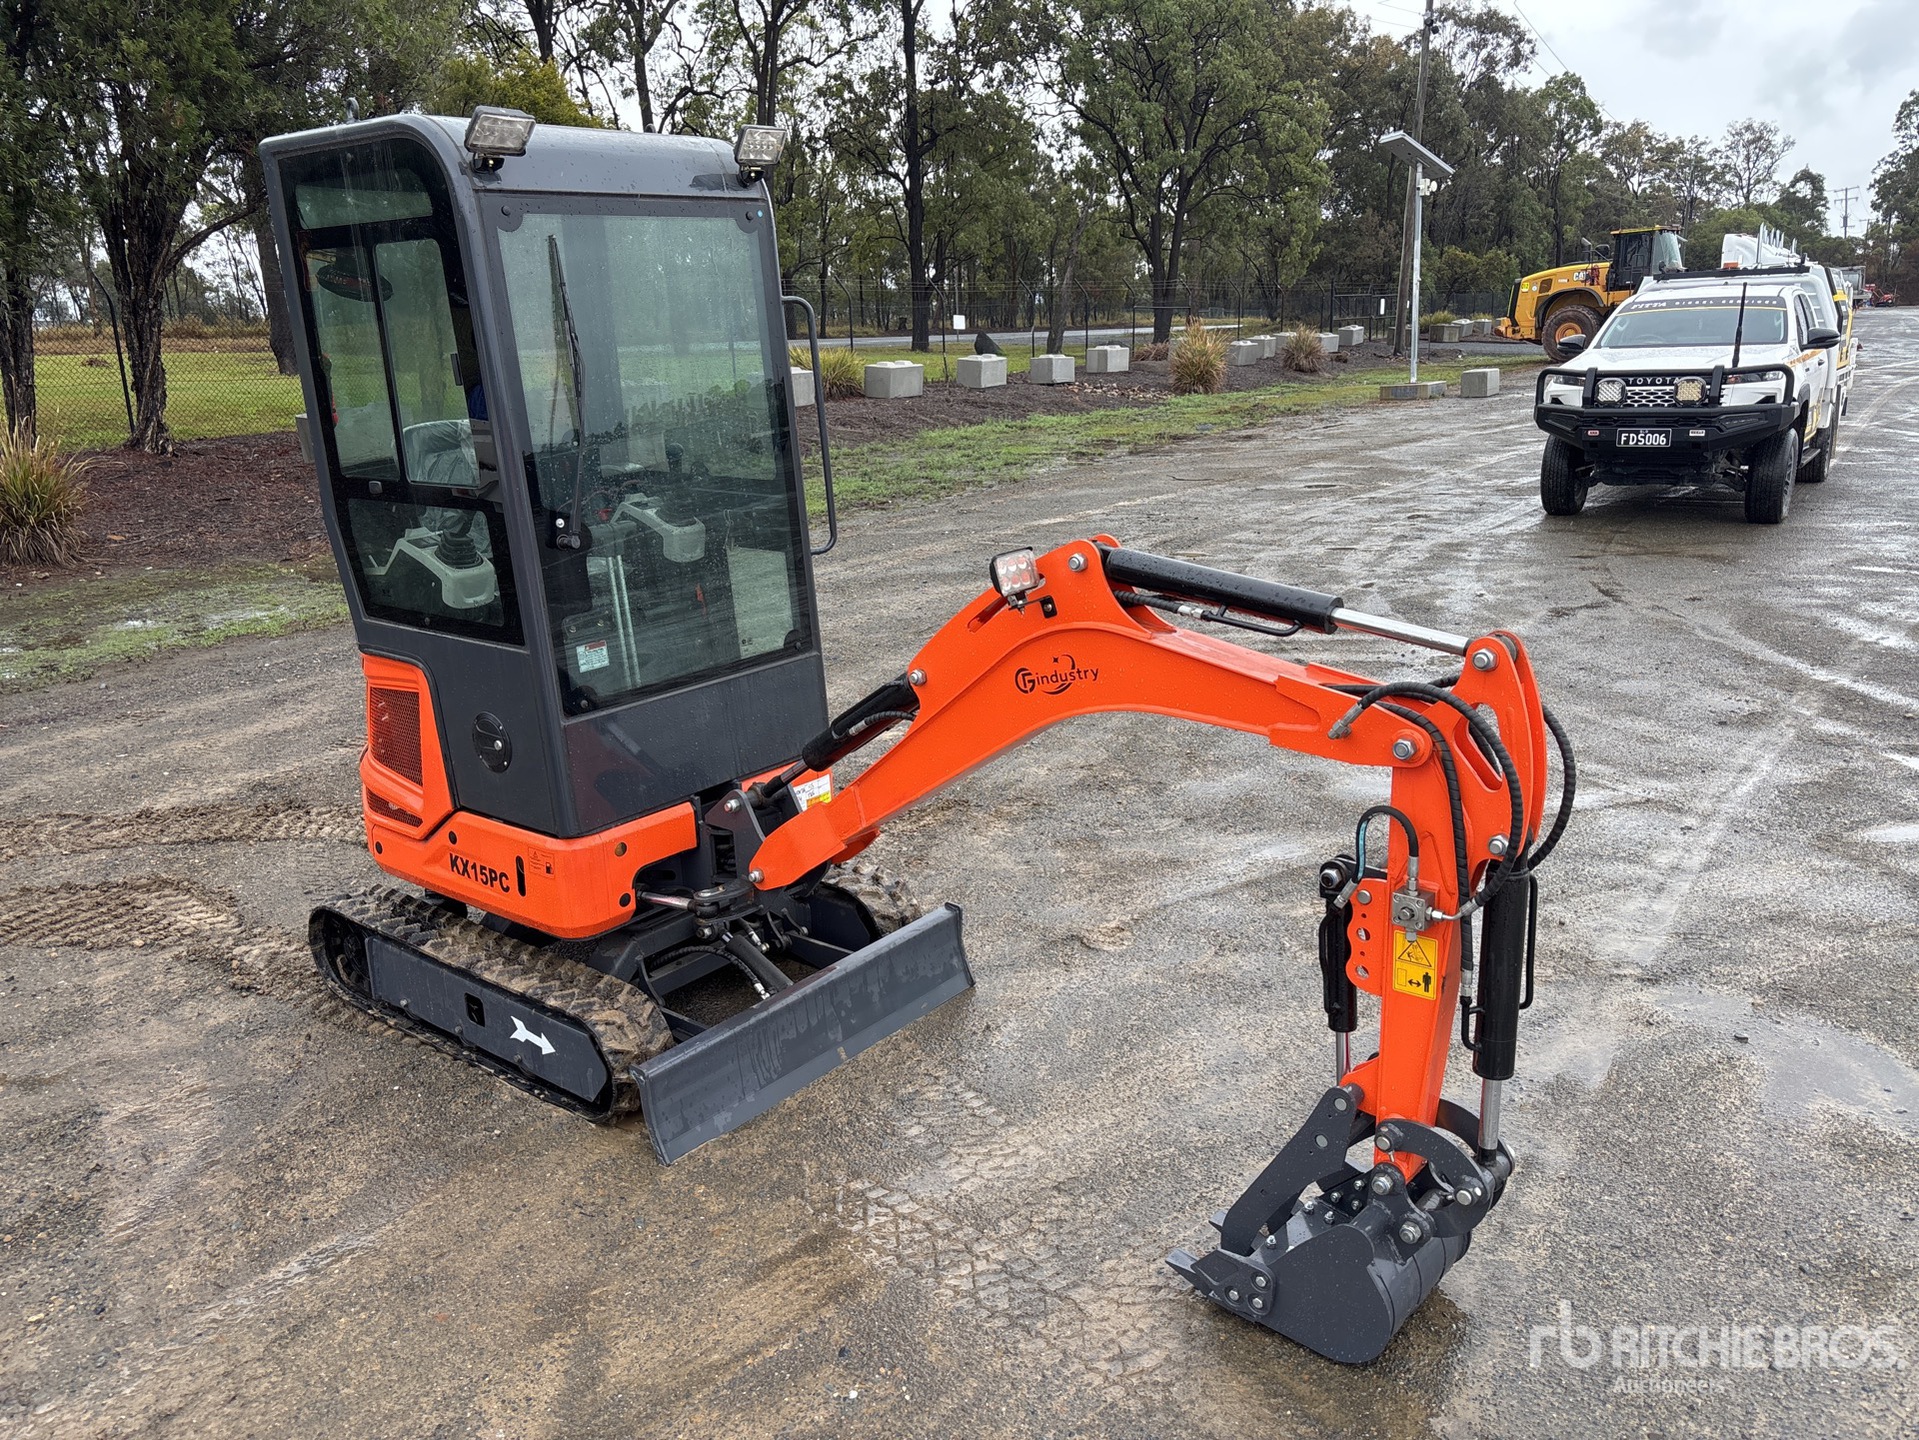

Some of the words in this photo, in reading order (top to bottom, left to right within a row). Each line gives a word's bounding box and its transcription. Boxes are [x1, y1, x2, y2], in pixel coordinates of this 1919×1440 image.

[1628, 377, 1680, 385] TOYOTA
[1620, 433, 1667, 446] FDS006
[449, 852, 511, 893] KX15PC
